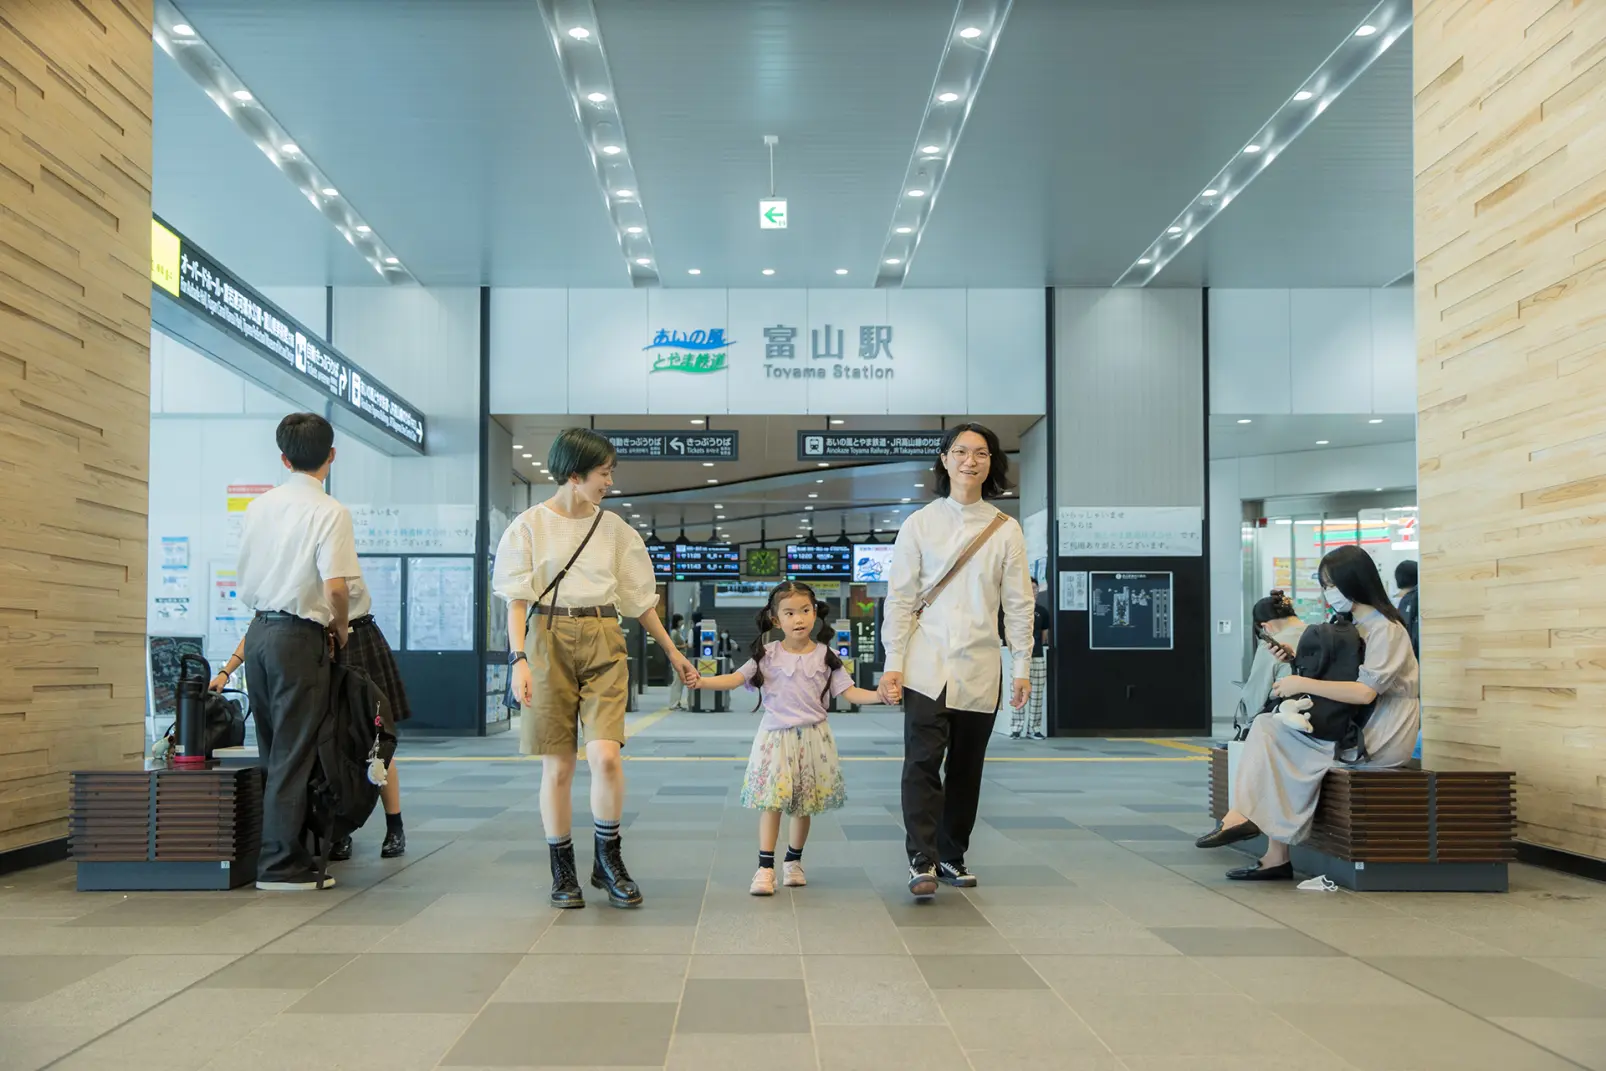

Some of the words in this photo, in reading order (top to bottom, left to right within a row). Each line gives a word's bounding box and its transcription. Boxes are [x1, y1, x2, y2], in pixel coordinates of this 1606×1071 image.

[653, 328, 727, 346] あいの風
[763, 324, 894, 360] 富山駅
[653, 352, 727, 369] とやま鉄道
[763, 364, 826, 380] Toyama
[833, 364, 894, 379] Station
[686, 437, 732, 447] きっぷうりば
[850, 447, 870, 456] Toyama
[900, 447, 924, 456] Takayama
